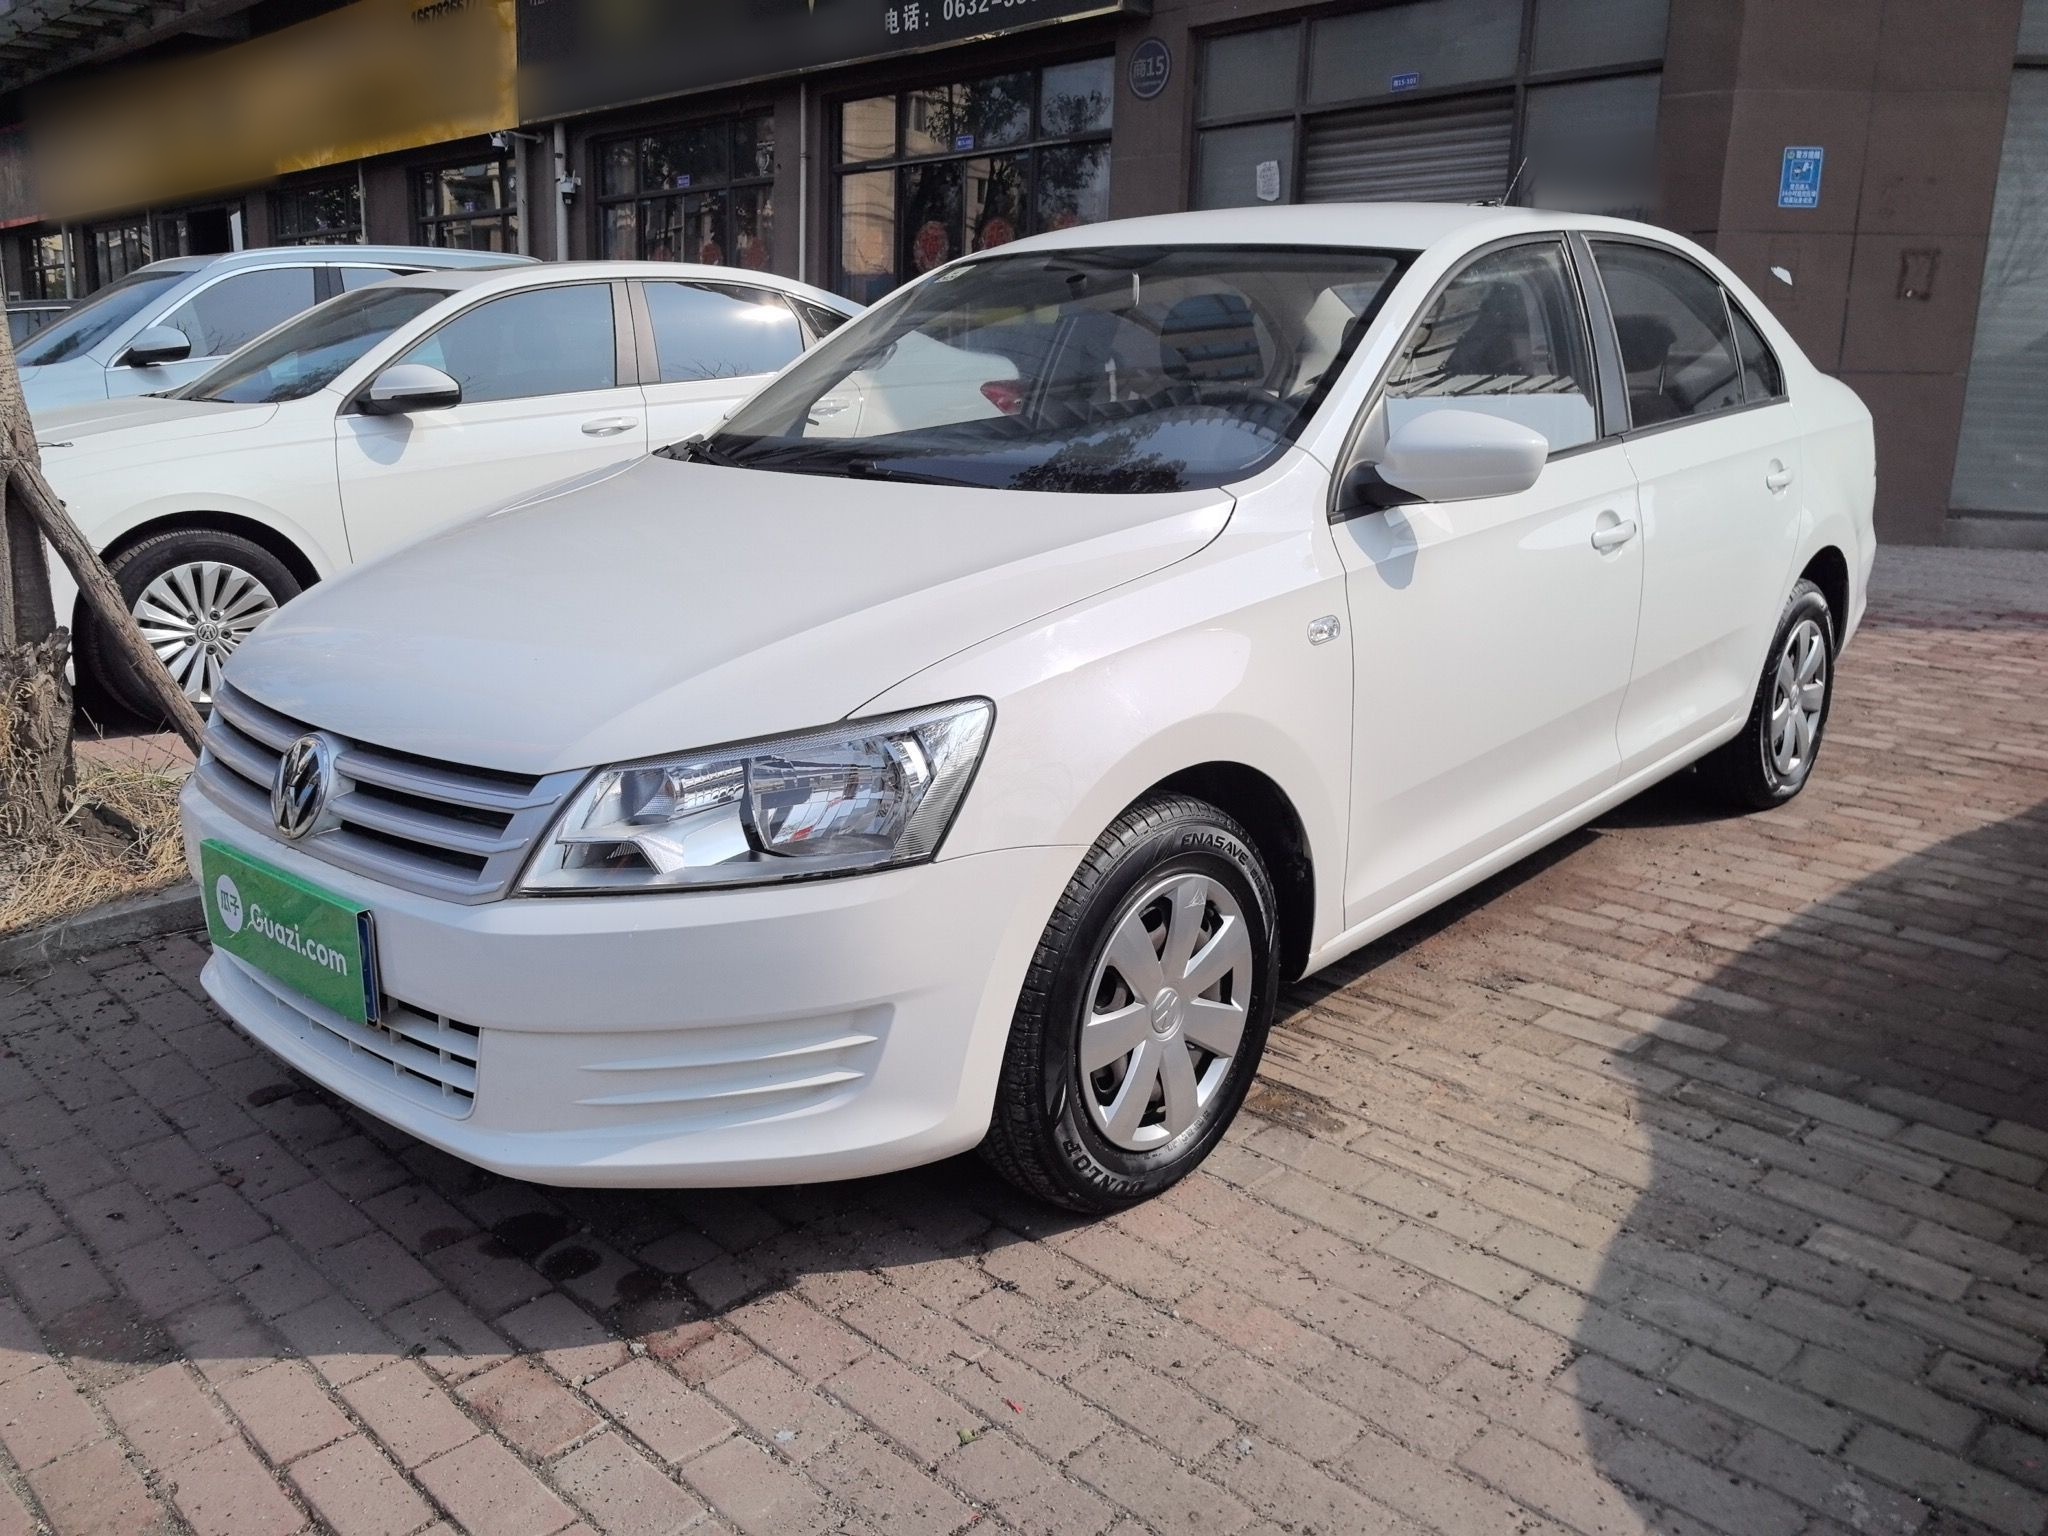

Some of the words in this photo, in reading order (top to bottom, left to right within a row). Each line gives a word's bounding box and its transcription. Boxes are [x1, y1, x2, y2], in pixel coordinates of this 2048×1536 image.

[1181, 832, 1249, 866] ENASAVE
[220, 889, 240, 917] 瓜子
[246, 903, 348, 977] Guazi.com
